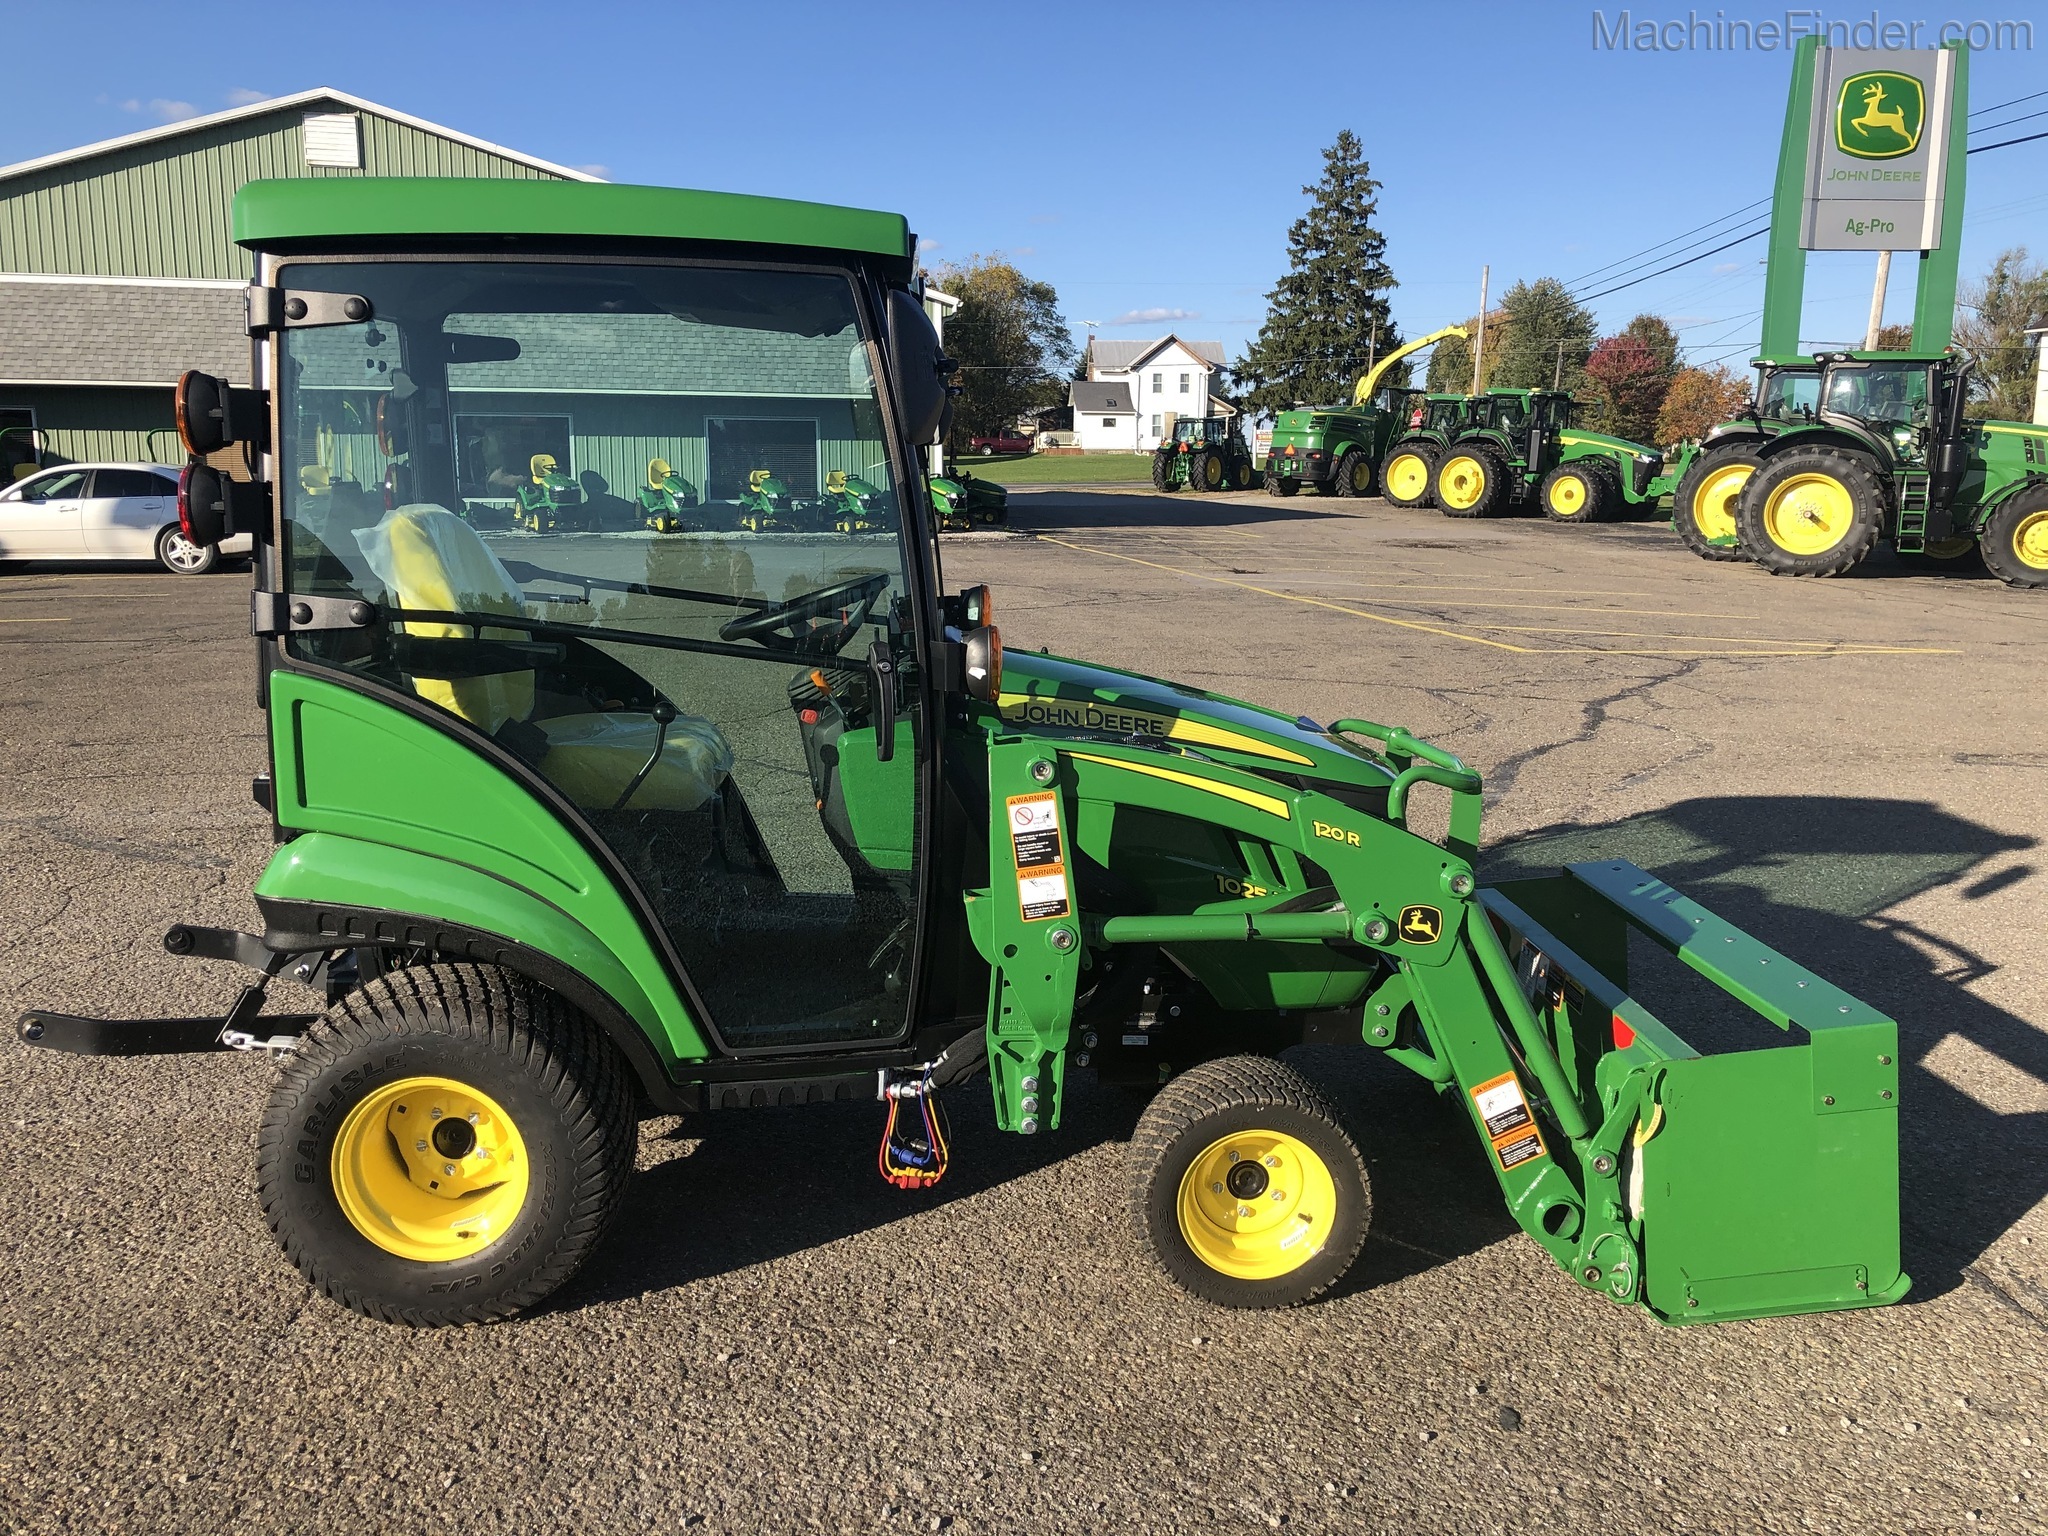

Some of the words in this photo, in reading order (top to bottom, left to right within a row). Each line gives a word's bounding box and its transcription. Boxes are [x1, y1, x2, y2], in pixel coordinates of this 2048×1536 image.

[1827, 168, 1869, 182] JOHN
[1872, 168, 1921, 182] DEERE
[1845, 217, 1895, 235] Ag-Pro
[1015, 703, 1079, 725] JOHN
[1086, 708, 1163, 736] DEERE
[1016, 793, 1053, 804] WARNING
[1026, 866, 1063, 877] WARNING
[294, 1052, 408, 1185] CARLISLE
